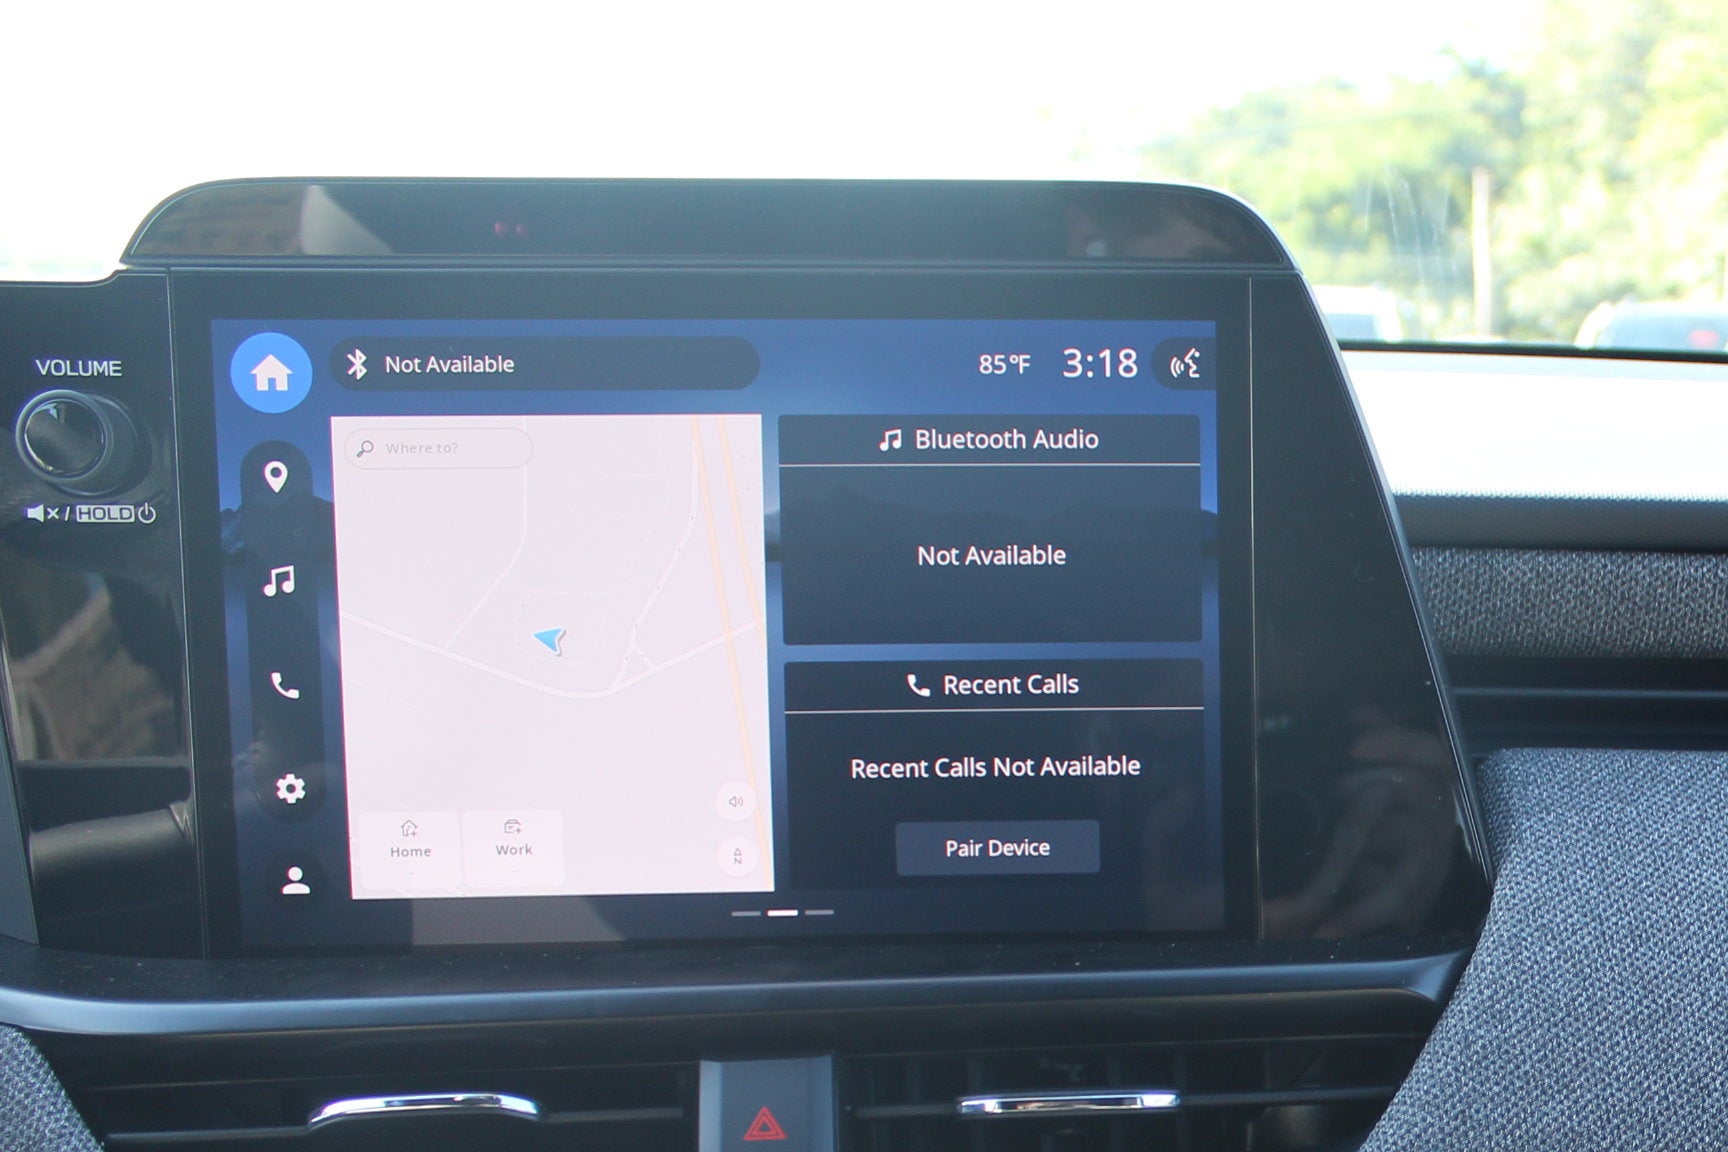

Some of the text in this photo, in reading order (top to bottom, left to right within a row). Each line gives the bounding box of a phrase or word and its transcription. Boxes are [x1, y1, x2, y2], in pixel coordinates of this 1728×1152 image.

[36, 359, 122, 377] VOLUME
[385, 354, 515, 373] Not Available
[1062, 348, 1138, 379] 3:18
[385, 442, 459, 454] Where to?
[915, 428, 1100, 450] Bluetooth Audio
[78, 506, 133, 521] HOLD
[917, 544, 1067, 566] Not Available
[944, 673, 1080, 695] Recent Calls
[851, 755, 1141, 779] Recent Calls Not Available
[390, 846, 432, 858] Home
[495, 844, 533, 857] Work
[945, 838, 1051, 859] Pair Device
